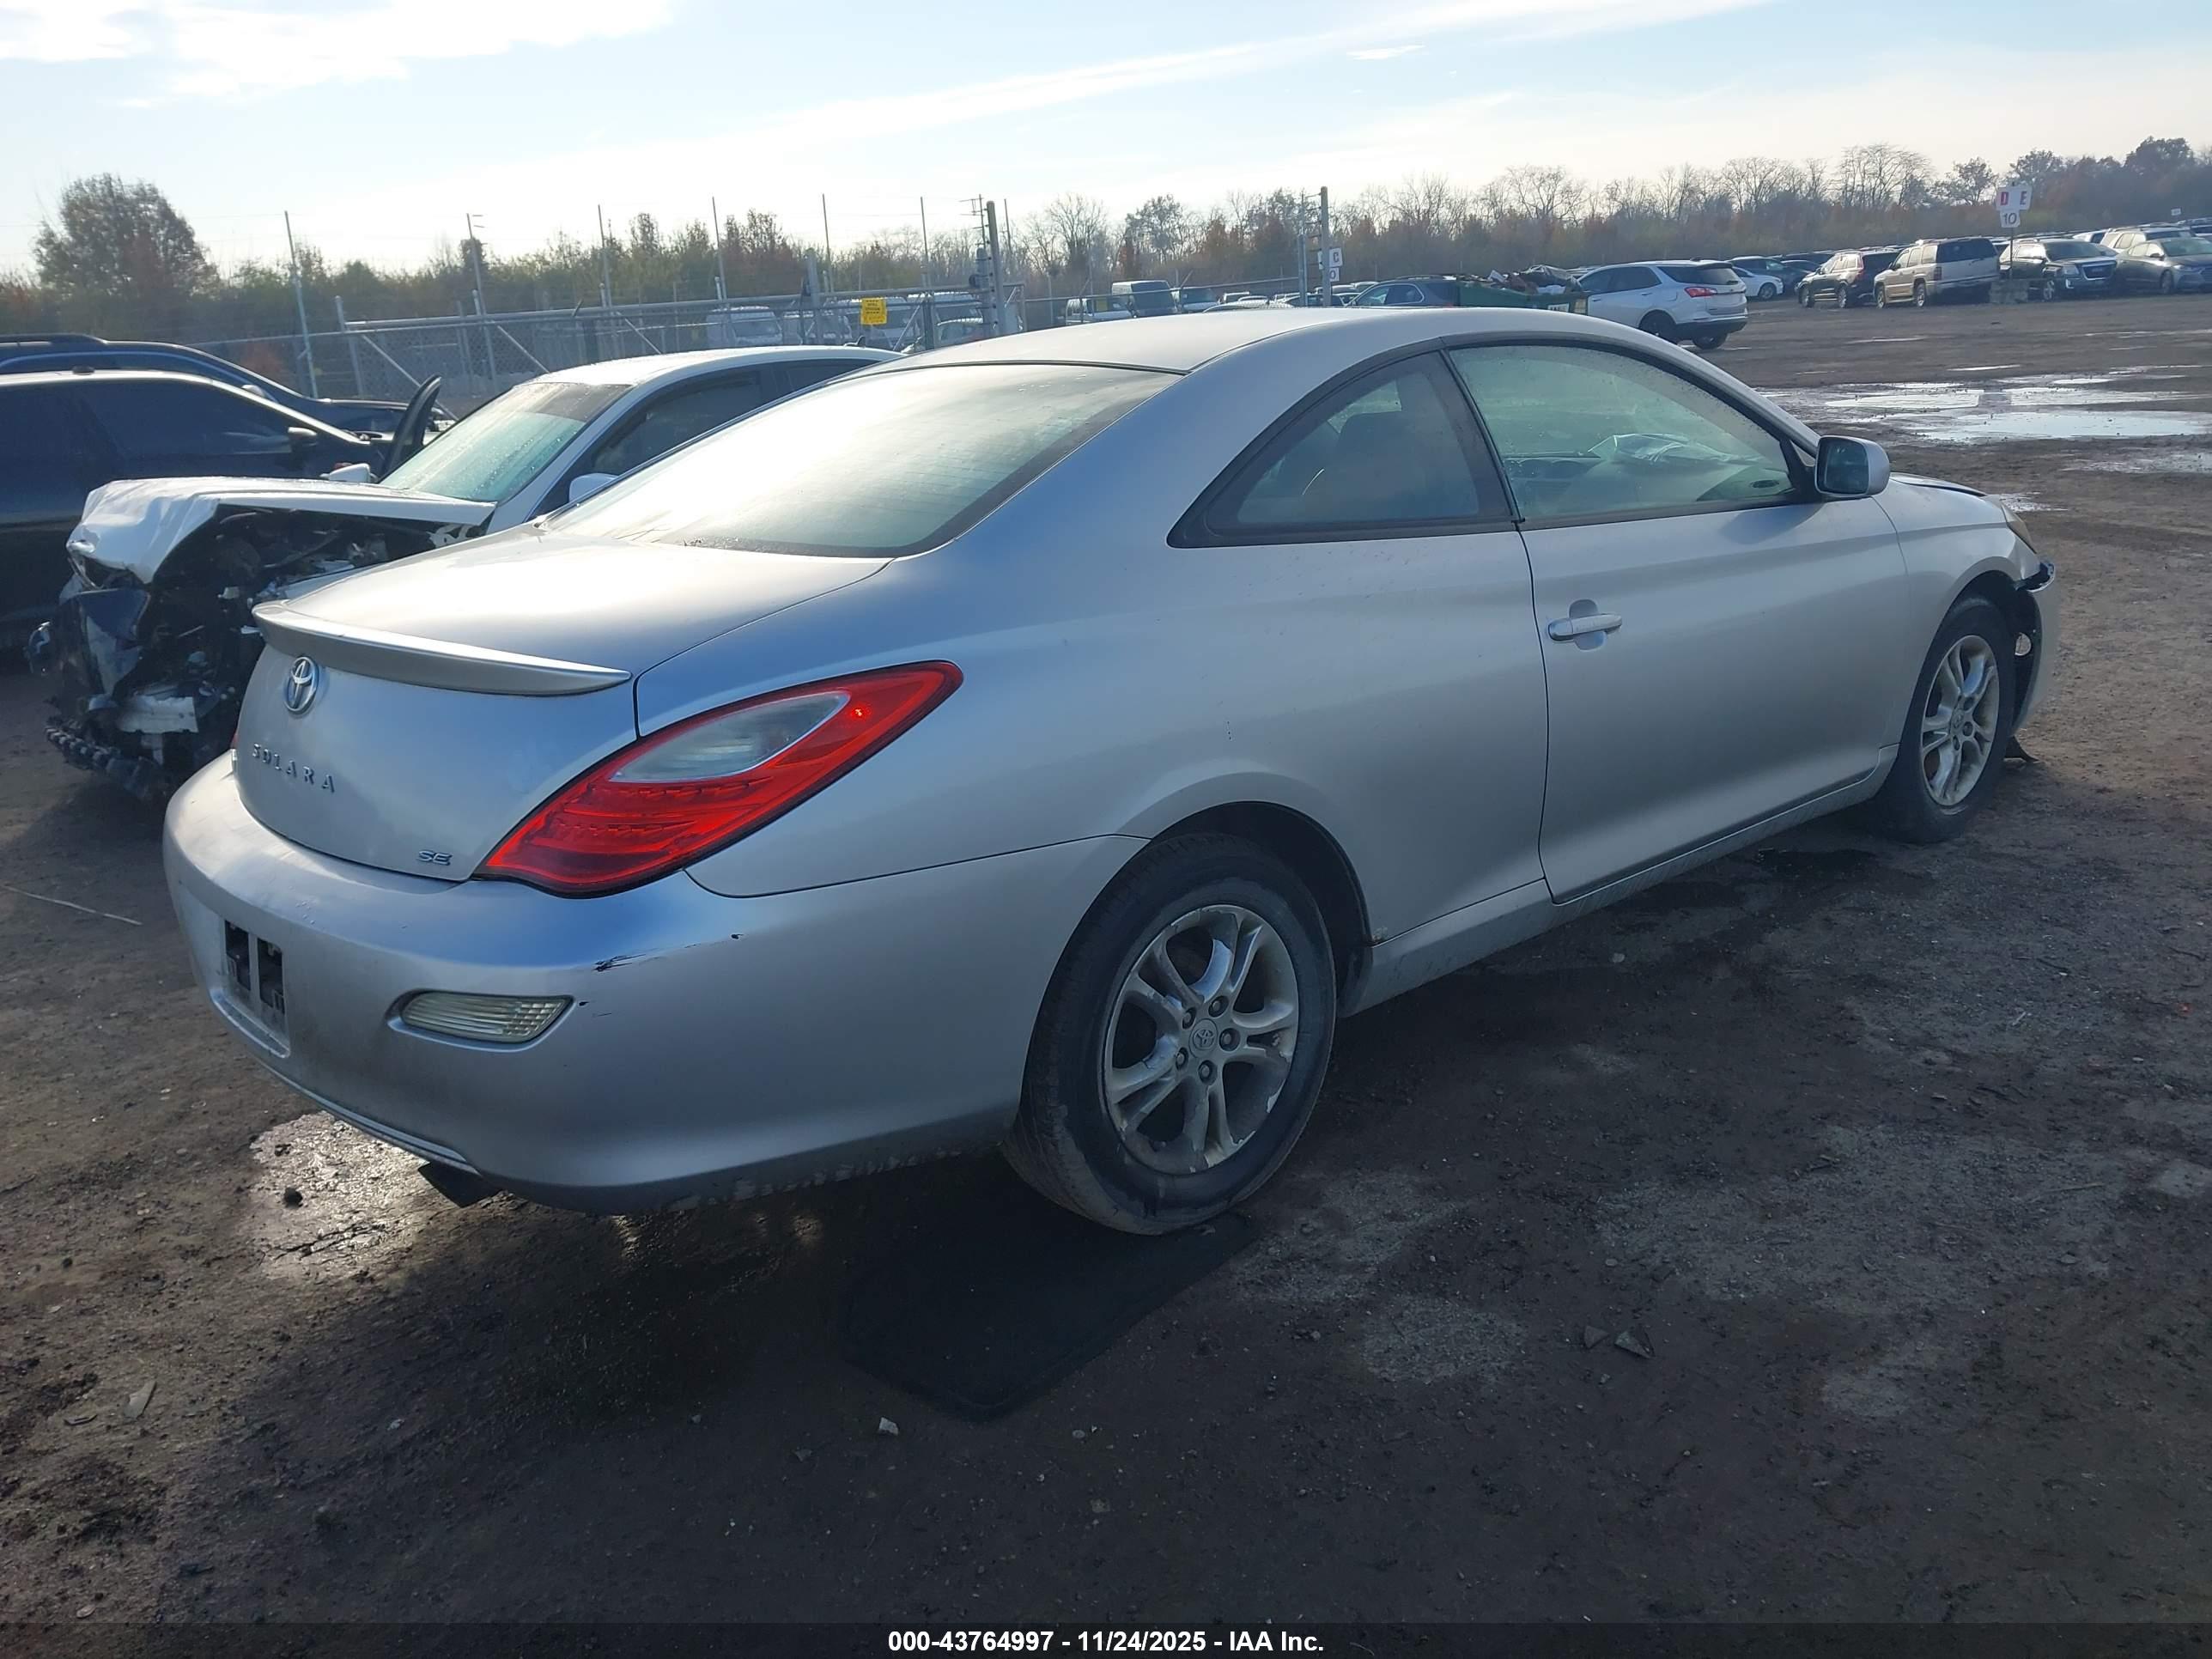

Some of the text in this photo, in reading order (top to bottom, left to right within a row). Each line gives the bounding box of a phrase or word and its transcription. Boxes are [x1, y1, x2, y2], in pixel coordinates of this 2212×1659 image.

[2000, 191, 2027, 205] D E
[2002, 213, 2017, 225] 10
[252, 742, 335, 793] SOLARA
[418, 849, 453, 866] SE
